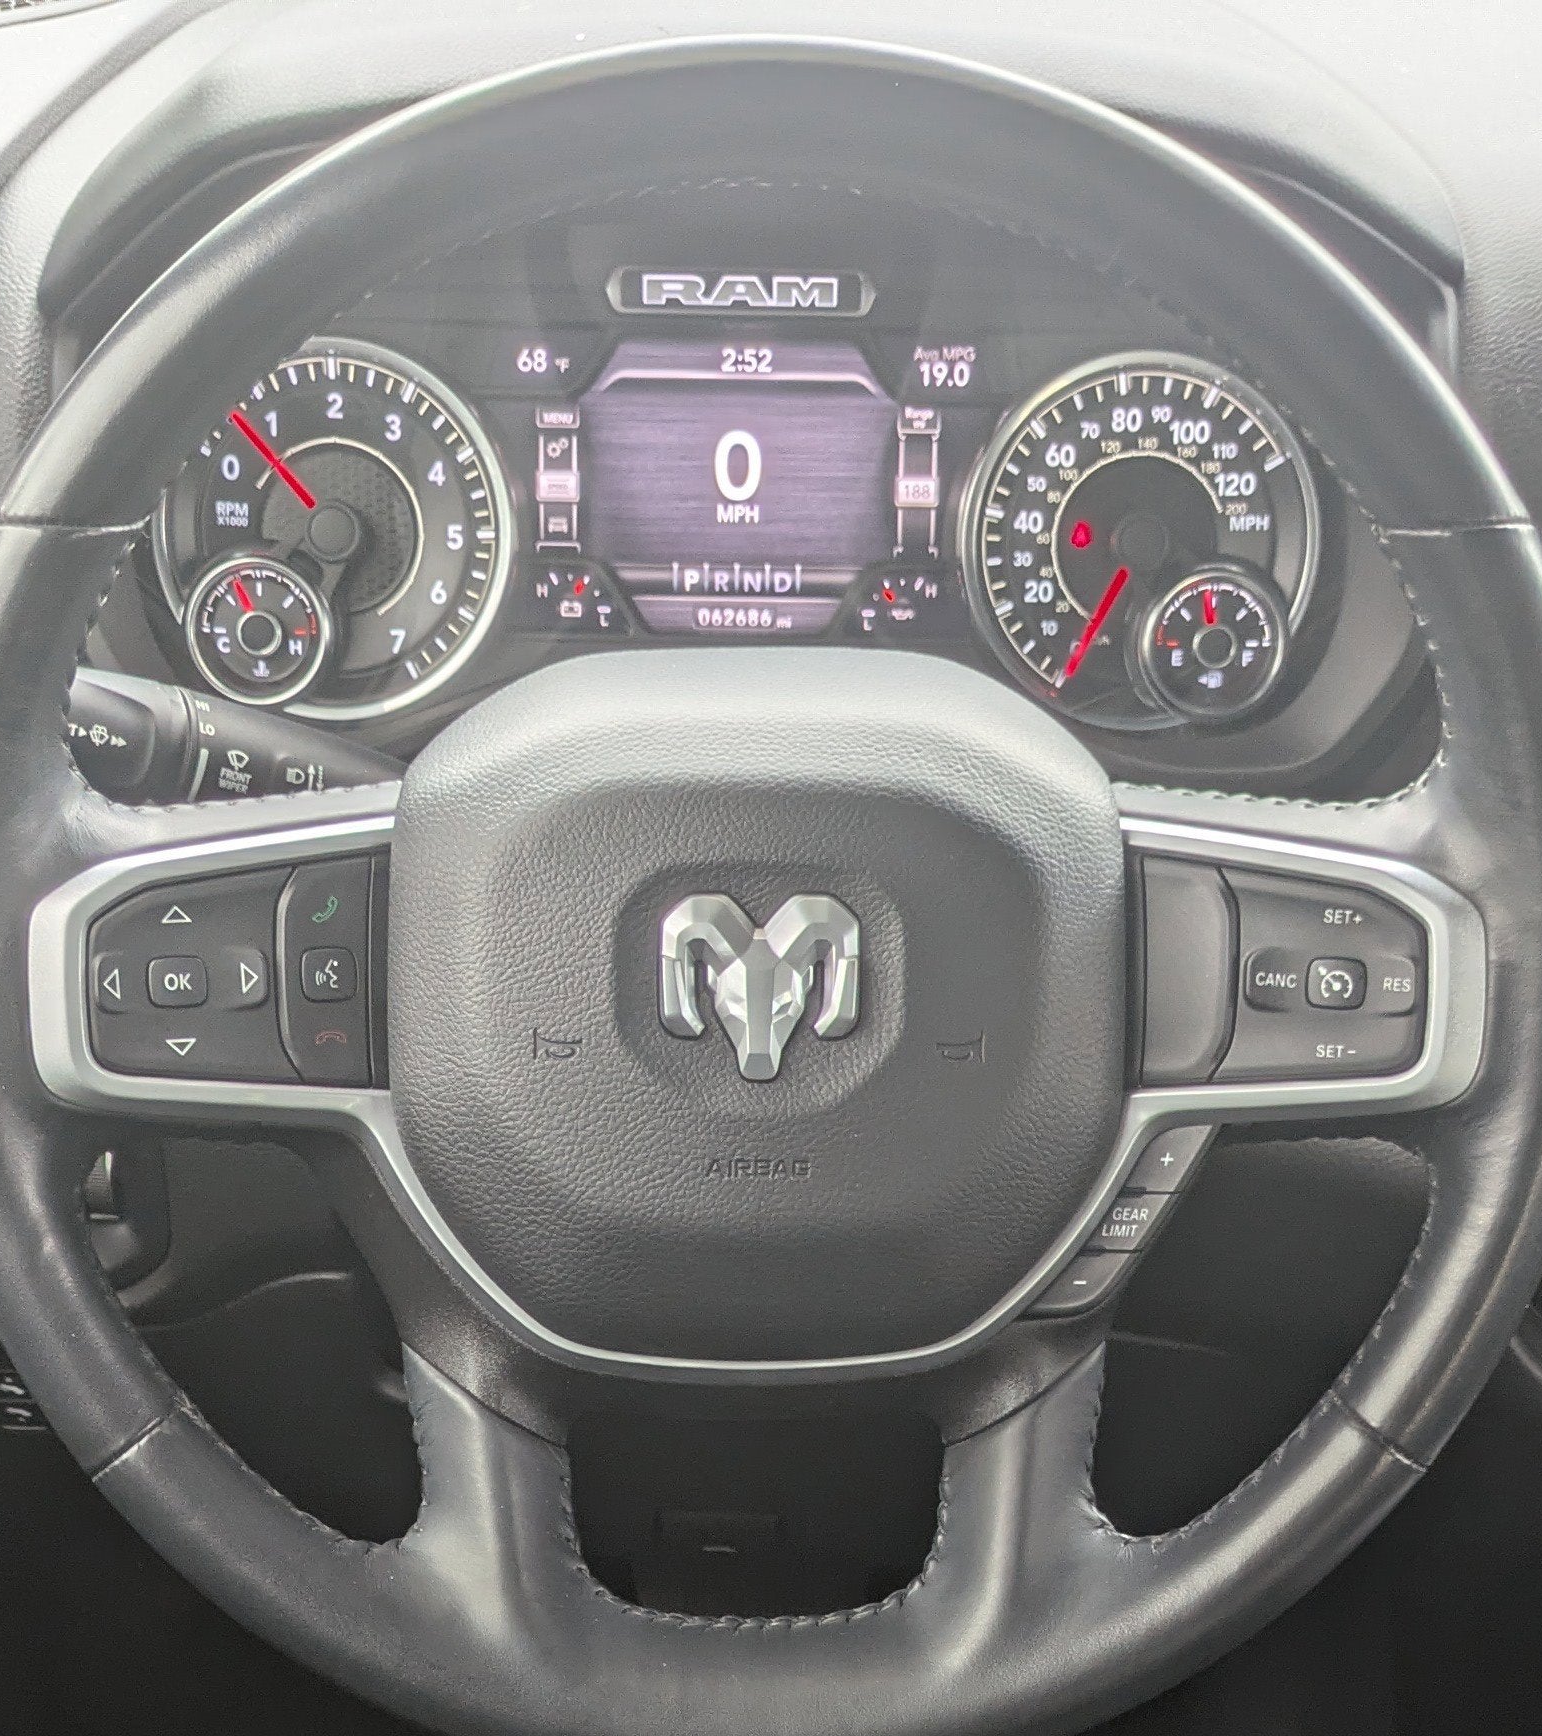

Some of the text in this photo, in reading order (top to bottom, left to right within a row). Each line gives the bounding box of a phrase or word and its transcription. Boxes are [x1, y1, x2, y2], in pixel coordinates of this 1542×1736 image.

[642, 274, 838, 307] RAM
[517, 349, 547, 373] 68
[721, 348, 773, 372] 2:52
[943, 346, 976, 362] MPG
[920, 361, 970, 387] 19.0
[326, 392, 344, 419] 2
[1151, 407, 1172, 424] 90
[264, 411, 277, 437] 1
[384, 414, 402, 441] 3
[1080, 423, 1100, 439] 70
[1111, 408, 1142, 433] 80
[1170, 420, 1210, 445] 100
[1045, 445, 1075, 468] 60
[1212, 443, 1238, 460] 110
[221, 455, 240, 480] 0
[427, 461, 446, 486] 4
[714, 431, 762, 501] 0
[1027, 476, 1047, 492] 50
[1214, 473, 1256, 497] 120
[215, 502, 249, 517] RPM
[717, 504, 760, 524] MPH
[1014, 511, 1043, 533] 40
[1229, 514, 1270, 532] MPH
[446, 524, 464, 550] 5
[1013, 552, 1033, 567] 30
[683, 568, 792, 592] P R N D
[430, 580, 447, 605] 6
[1024, 581, 1053, 603] 20
[1041, 621, 1058, 636] 10
[216, 637, 230, 653] C
[288, 639, 302, 656] H
[389, 629, 406, 654] 7
[1171, 650, 1183, 667] E
[1241, 651, 1254, 667] F
[1323, 909, 1364, 925] SET+
[164, 971, 192, 991] OK
[1255, 973, 1297, 989] CANC
[1383, 977, 1412, 993] RES
[1316, 1045, 1343, 1058] SET
[705, 1157, 812, 1179] AIRBAG
[1112, 1207, 1148, 1222] GEAR
[1102, 1224, 1137, 1238] LIMIT
